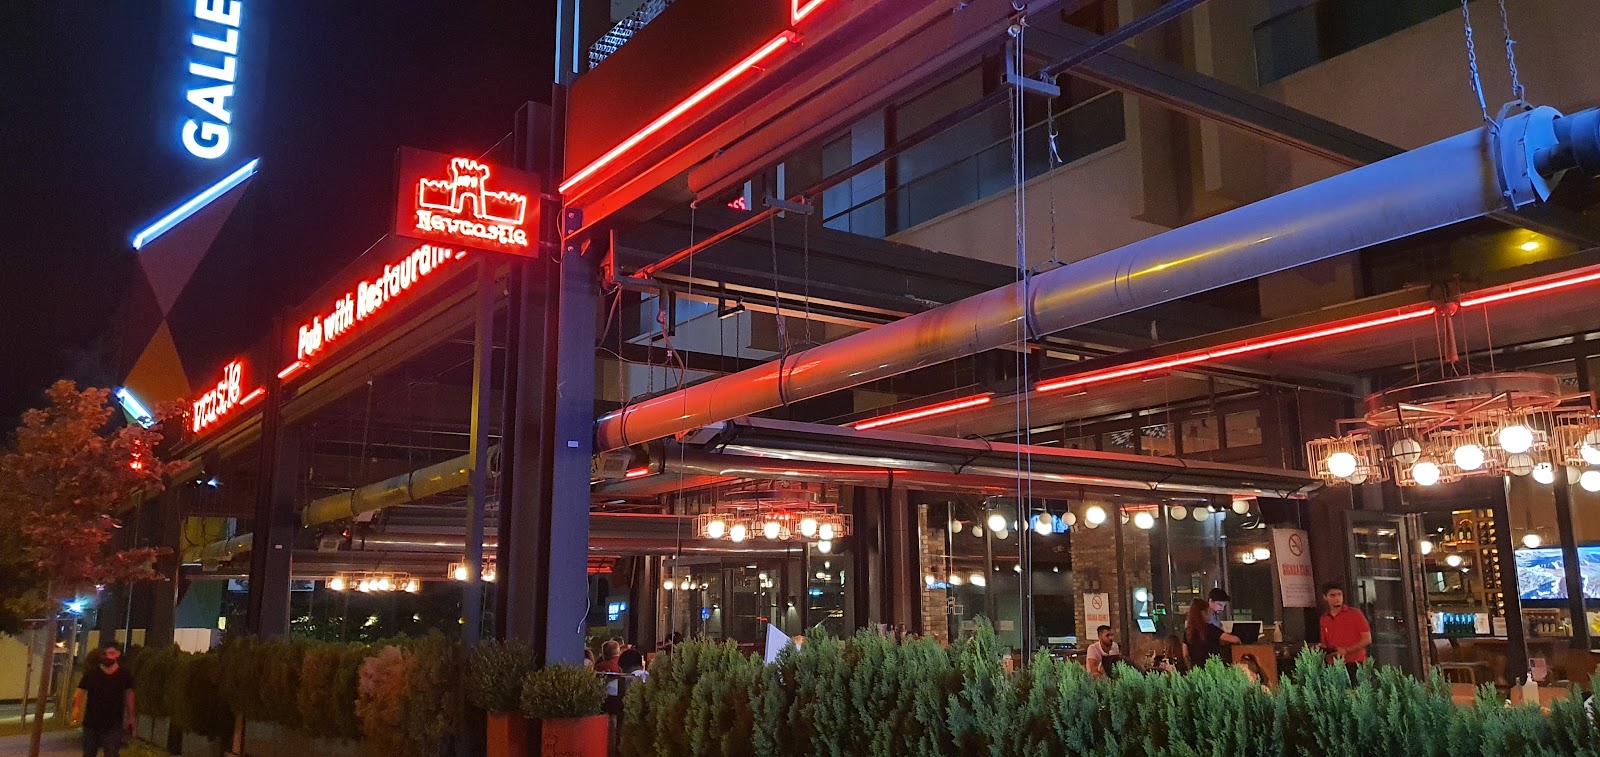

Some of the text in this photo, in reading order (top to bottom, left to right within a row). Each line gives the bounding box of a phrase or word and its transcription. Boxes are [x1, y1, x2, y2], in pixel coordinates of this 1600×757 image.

[182, 0, 241, 159] GALLE
[416, 209, 528, 247] Newcastle
[298, 316, 322, 359] Pub
[324, 292, 354, 342] with
